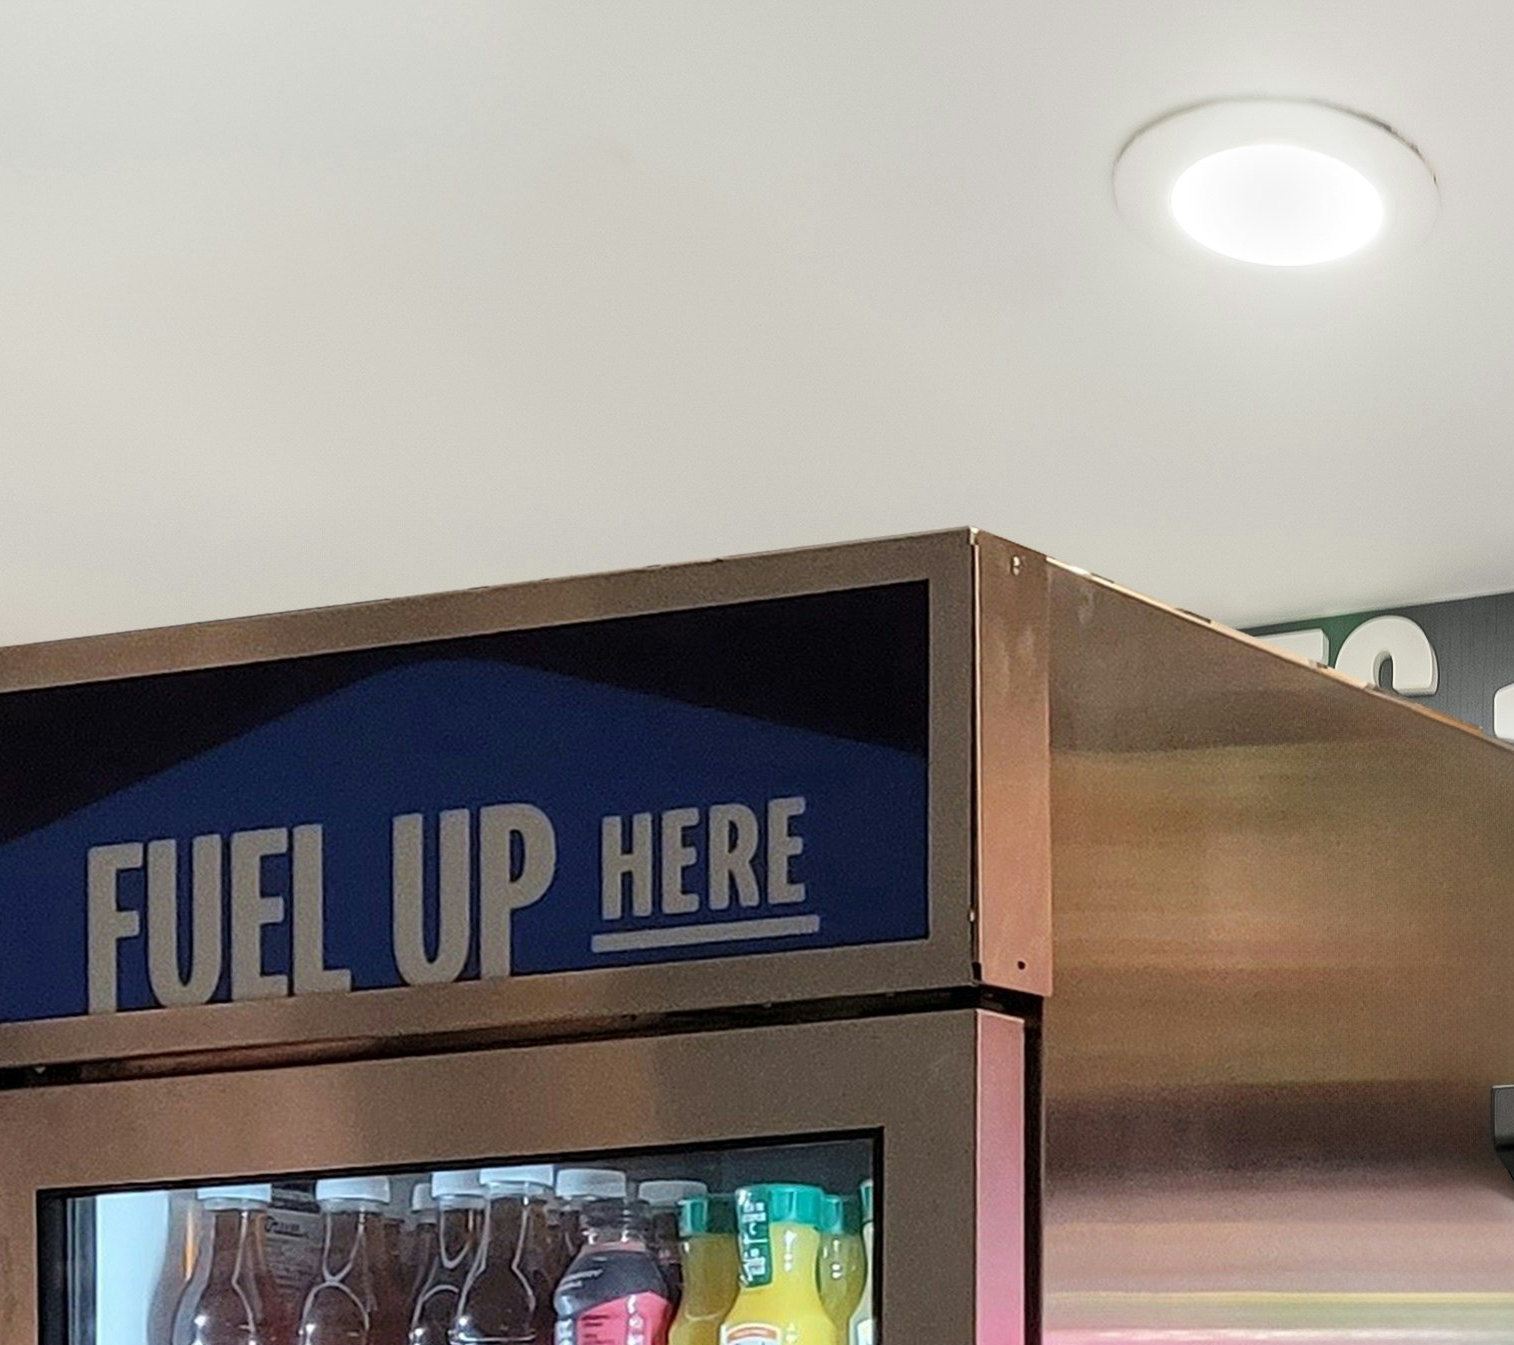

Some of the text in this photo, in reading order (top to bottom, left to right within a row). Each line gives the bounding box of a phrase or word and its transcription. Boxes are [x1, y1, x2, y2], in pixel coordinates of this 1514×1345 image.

[87, 795, 807, 1014] FUEL UP HERE
